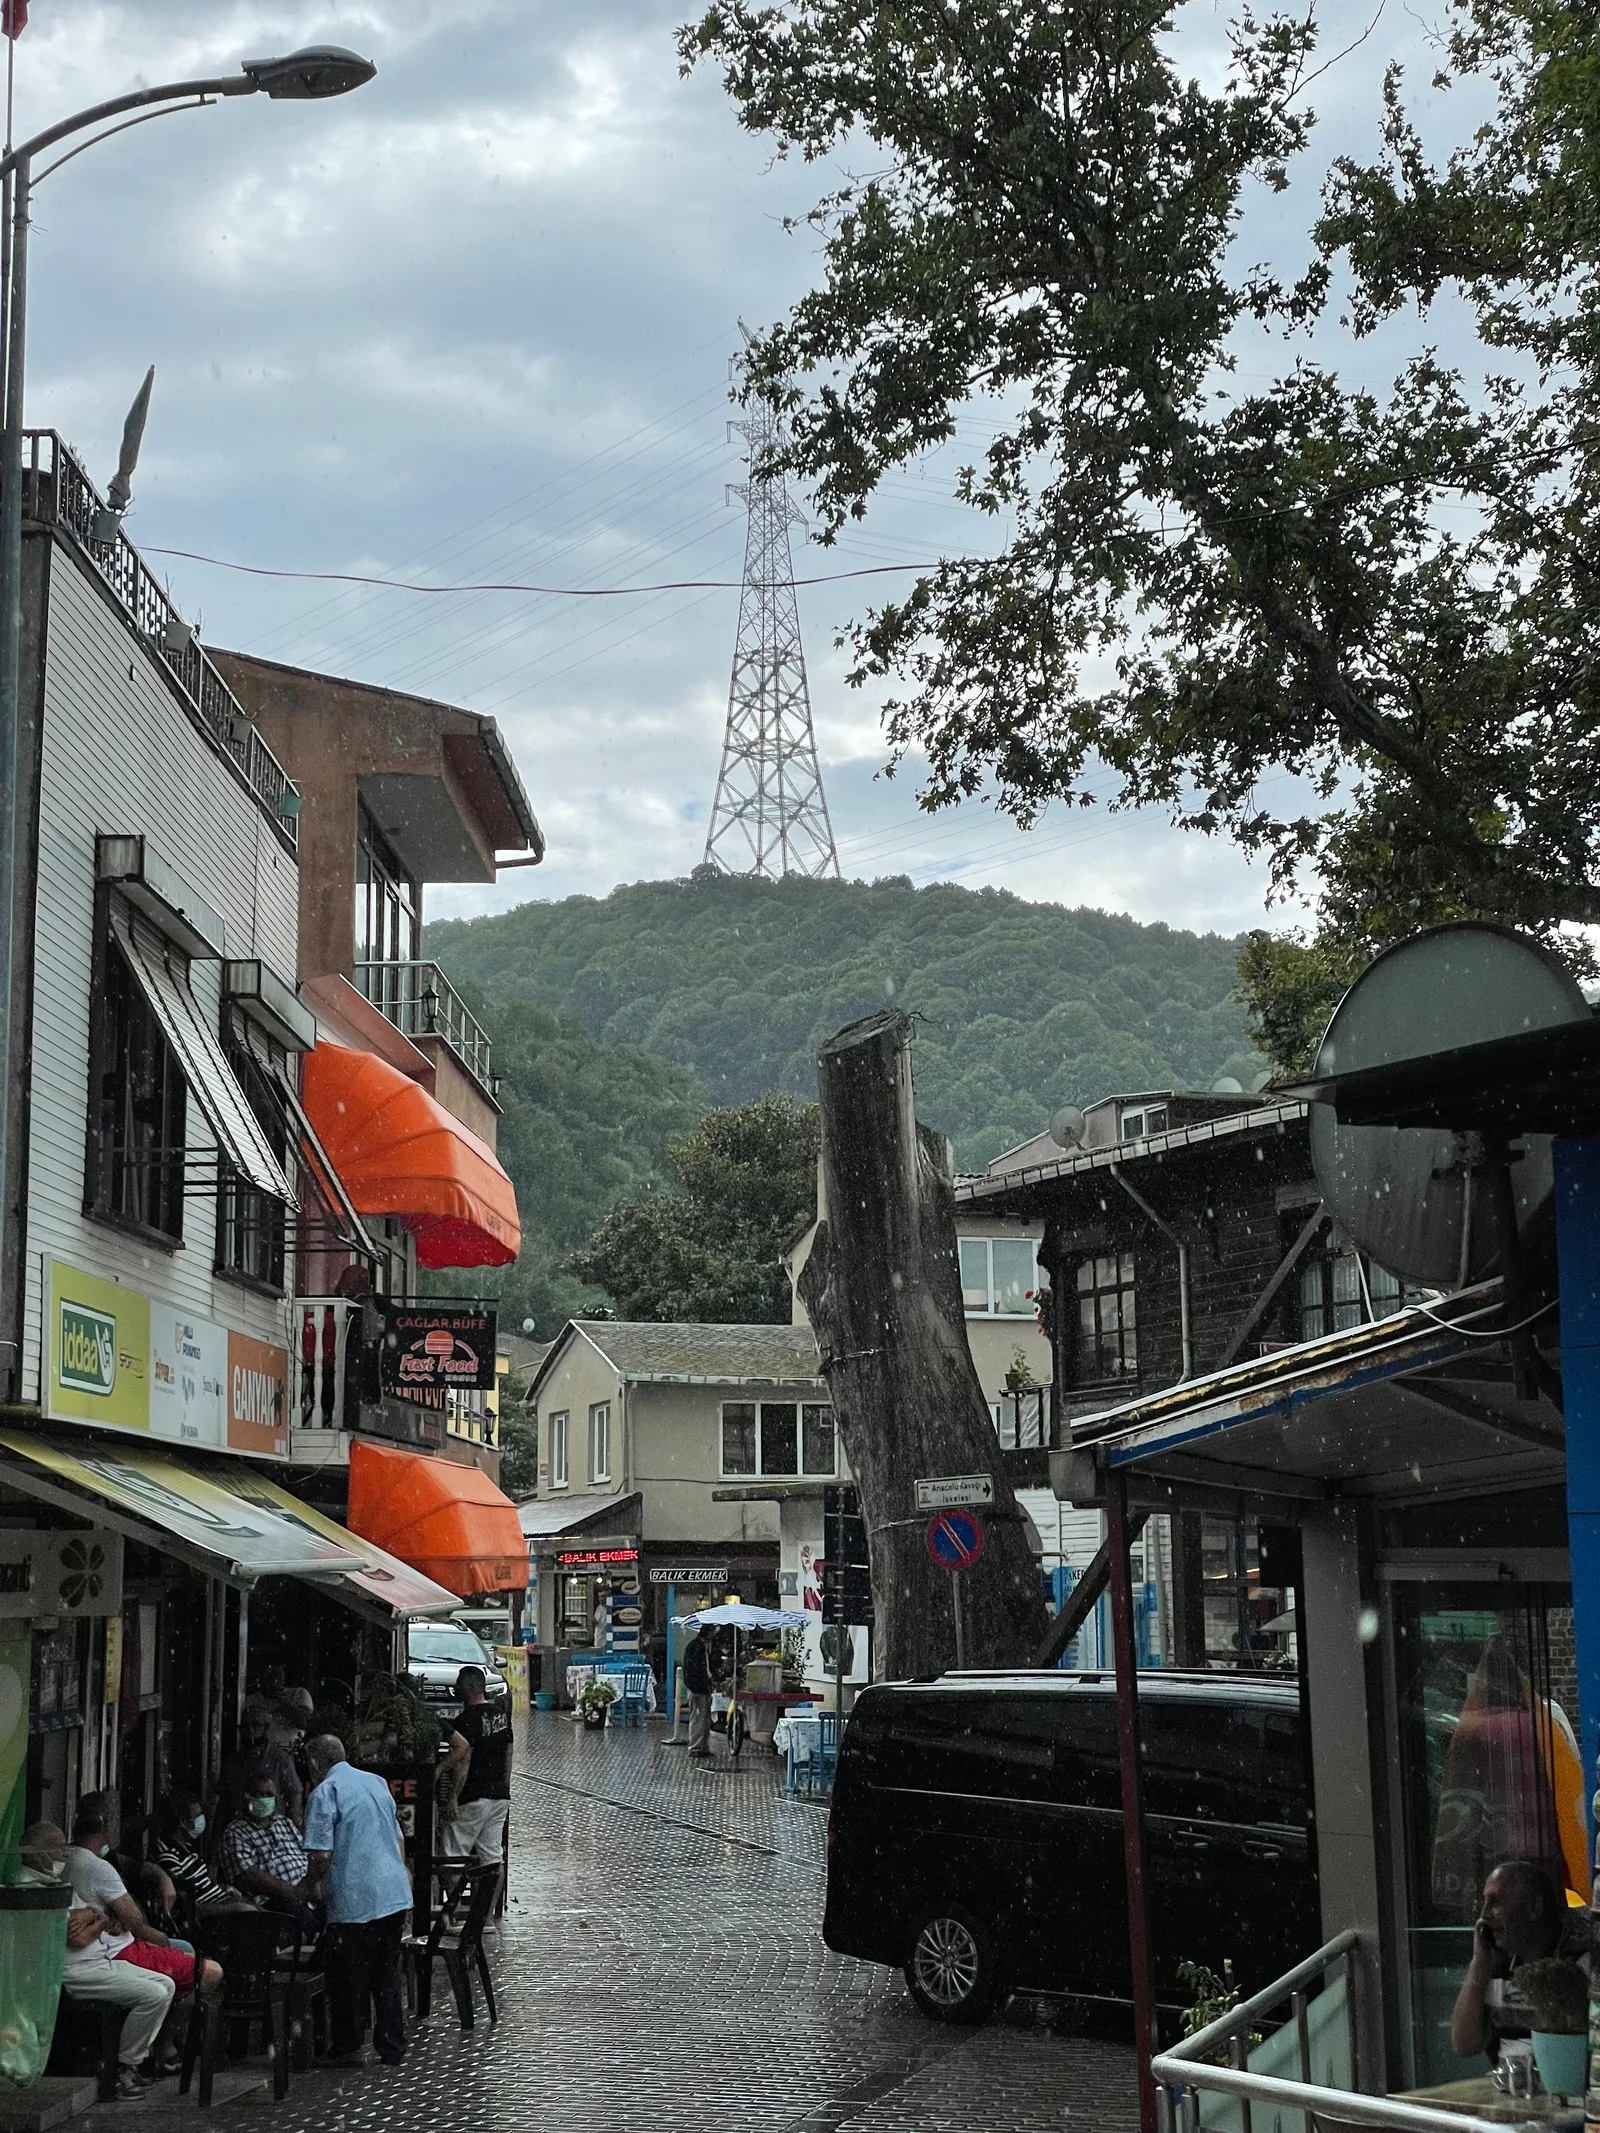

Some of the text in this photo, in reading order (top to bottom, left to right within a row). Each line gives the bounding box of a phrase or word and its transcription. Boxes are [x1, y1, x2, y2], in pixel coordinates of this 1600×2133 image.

[63, 1319, 98, 1375] iddaa
[400, 1354, 479, 1373] Fast Food
[233, 1364, 275, 1427] GANYAN
[931, 1483, 959, 1492] Anadolu
[942, 1494, 972, 1503] İskelesi
[564, 1550, 639, 1563] BALIK EKMEK
[652, 1570, 727, 1581] BALIK EKMEK
